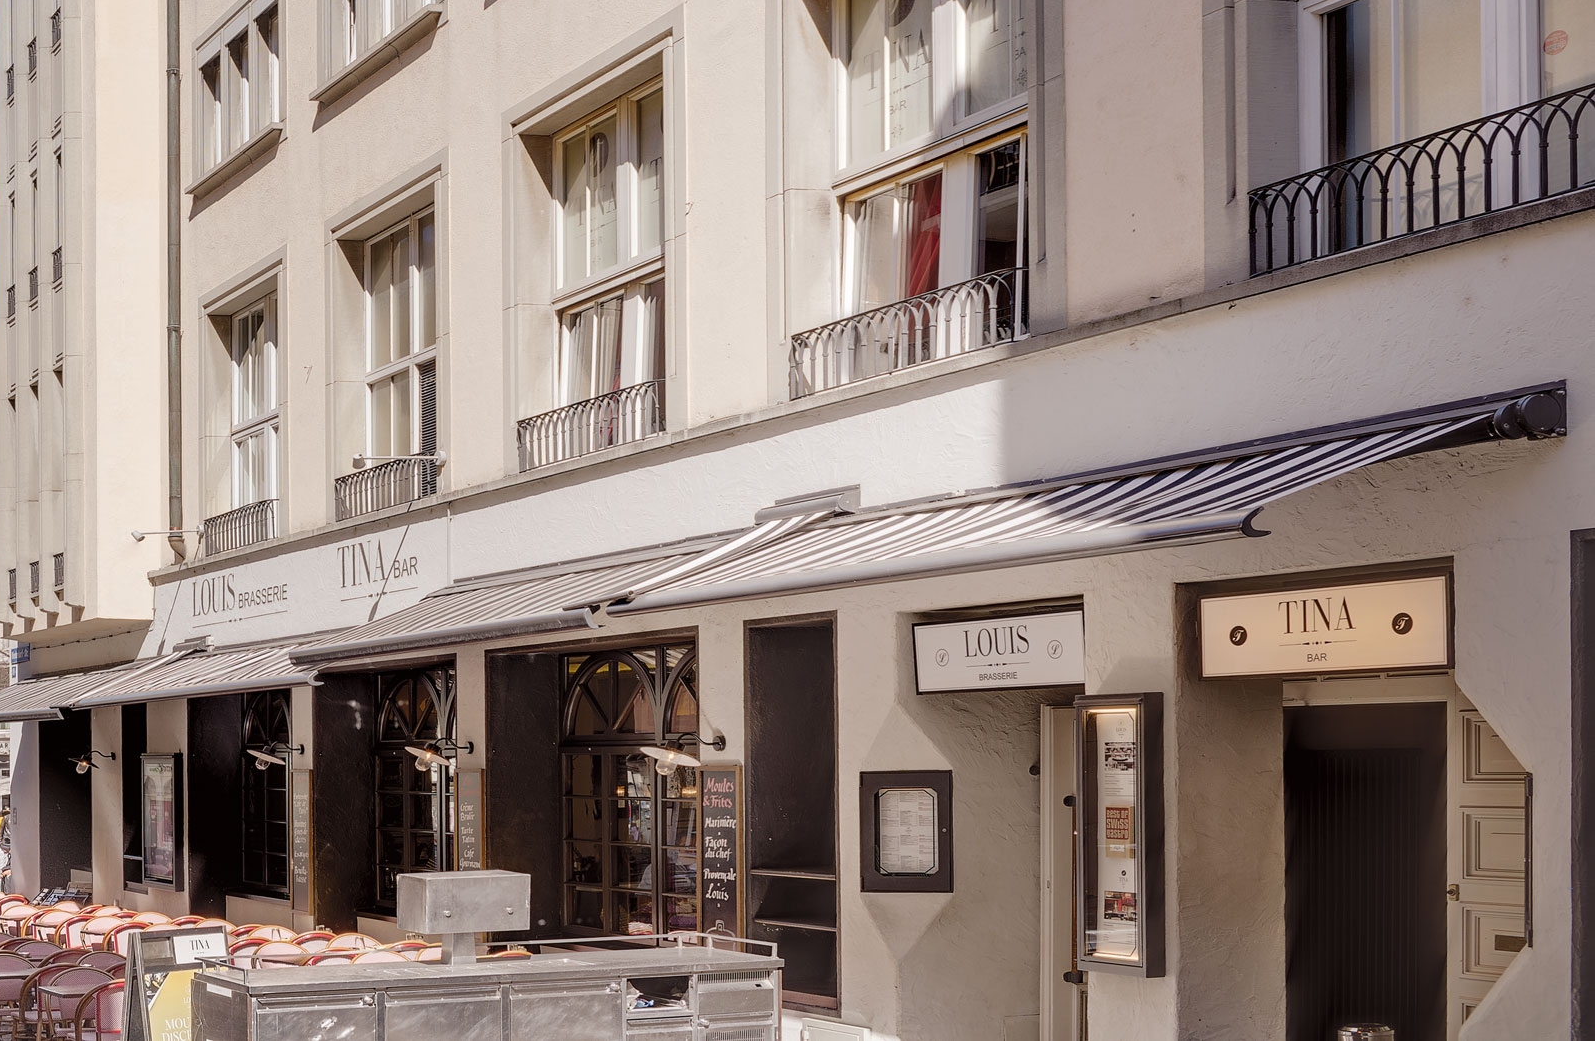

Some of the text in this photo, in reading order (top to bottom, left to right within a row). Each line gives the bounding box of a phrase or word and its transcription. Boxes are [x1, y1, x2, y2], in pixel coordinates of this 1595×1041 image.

[337, 538, 418, 589] TINA BAR
[192, 573, 288, 617] LOUIS BRASSERIE
[1278, 595, 1356, 635] TINA
[963, 625, 1030, 658] LOUIS
[1306, 652, 1327, 663] BAR
[978, 671, 1018, 682] BRASSERIE
[704, 777, 735, 793] Moules
[704, 815, 737, 829] Marinière
[705, 836, 728, 851] Façon
[705, 847, 733, 861] du chef
[703, 867, 737, 883] Provençale
[706, 883, 729, 901] Louis
[190, 939, 210, 951] TINA
